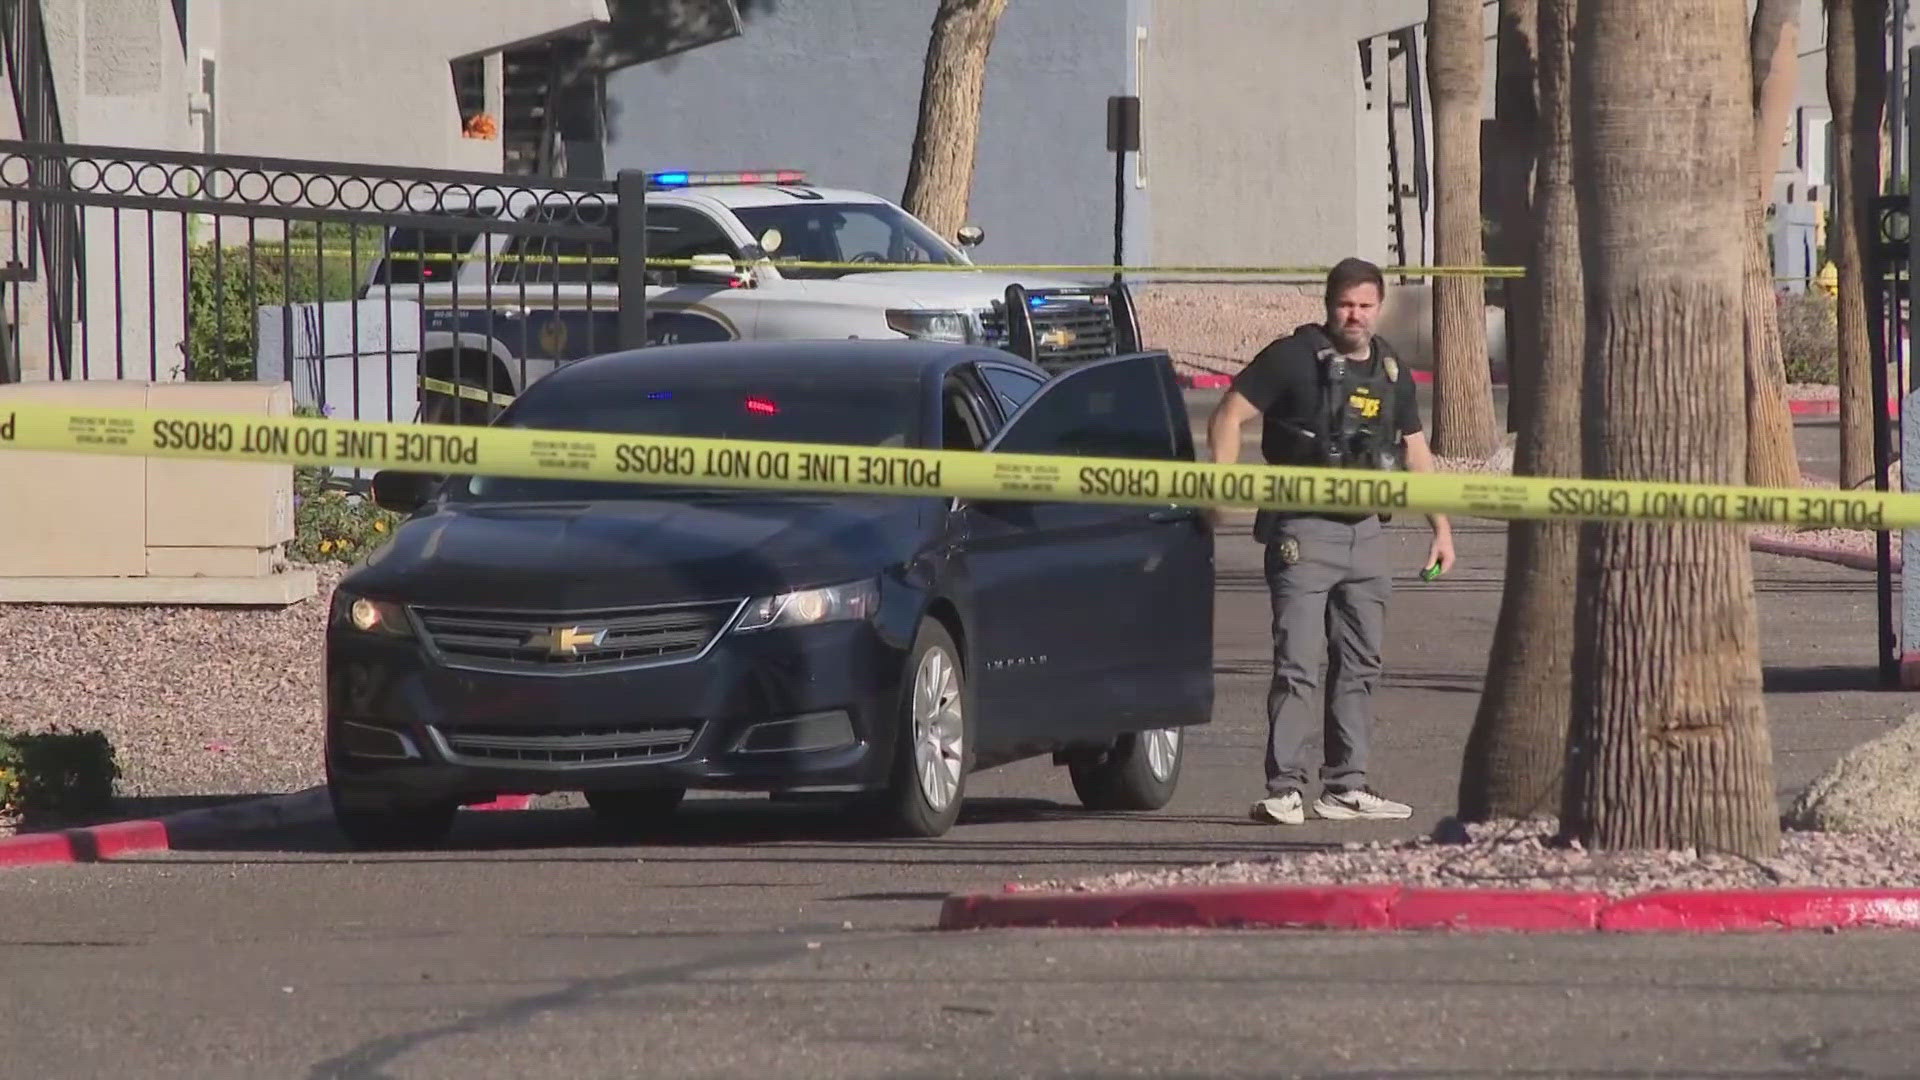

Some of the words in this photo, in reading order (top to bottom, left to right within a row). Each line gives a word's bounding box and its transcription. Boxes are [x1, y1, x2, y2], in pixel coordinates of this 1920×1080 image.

[153, 419, 232, 451] CROSS
[241, 424, 294, 453] NOT
[297, 427, 326, 456] DO
[336, 430, 387, 459] LINE
[395, 433, 478, 465] POLICE
[615, 444, 694, 475] CROSS
[703, 449, 750, 478] NOT
[757, 450, 789, 479] DO
[798, 453, 849, 482] LINE
[859, 456, 940, 487] POLICE
[1079, 467, 1158, 495] CROSS
[1168, 470, 1215, 498] NOT
[1221, 472, 1254, 500] DO
[1263, 474, 1315, 503] LINE
[1324, 478, 1407, 507] POLICE
[1548, 487, 1630, 514] CROSS
[1640, 490, 1686, 517] NOT
[1692, 492, 1727, 519] DO
[1736, 495, 1789, 521] LINE
[1799, 498, 1884, 526] POLICE
